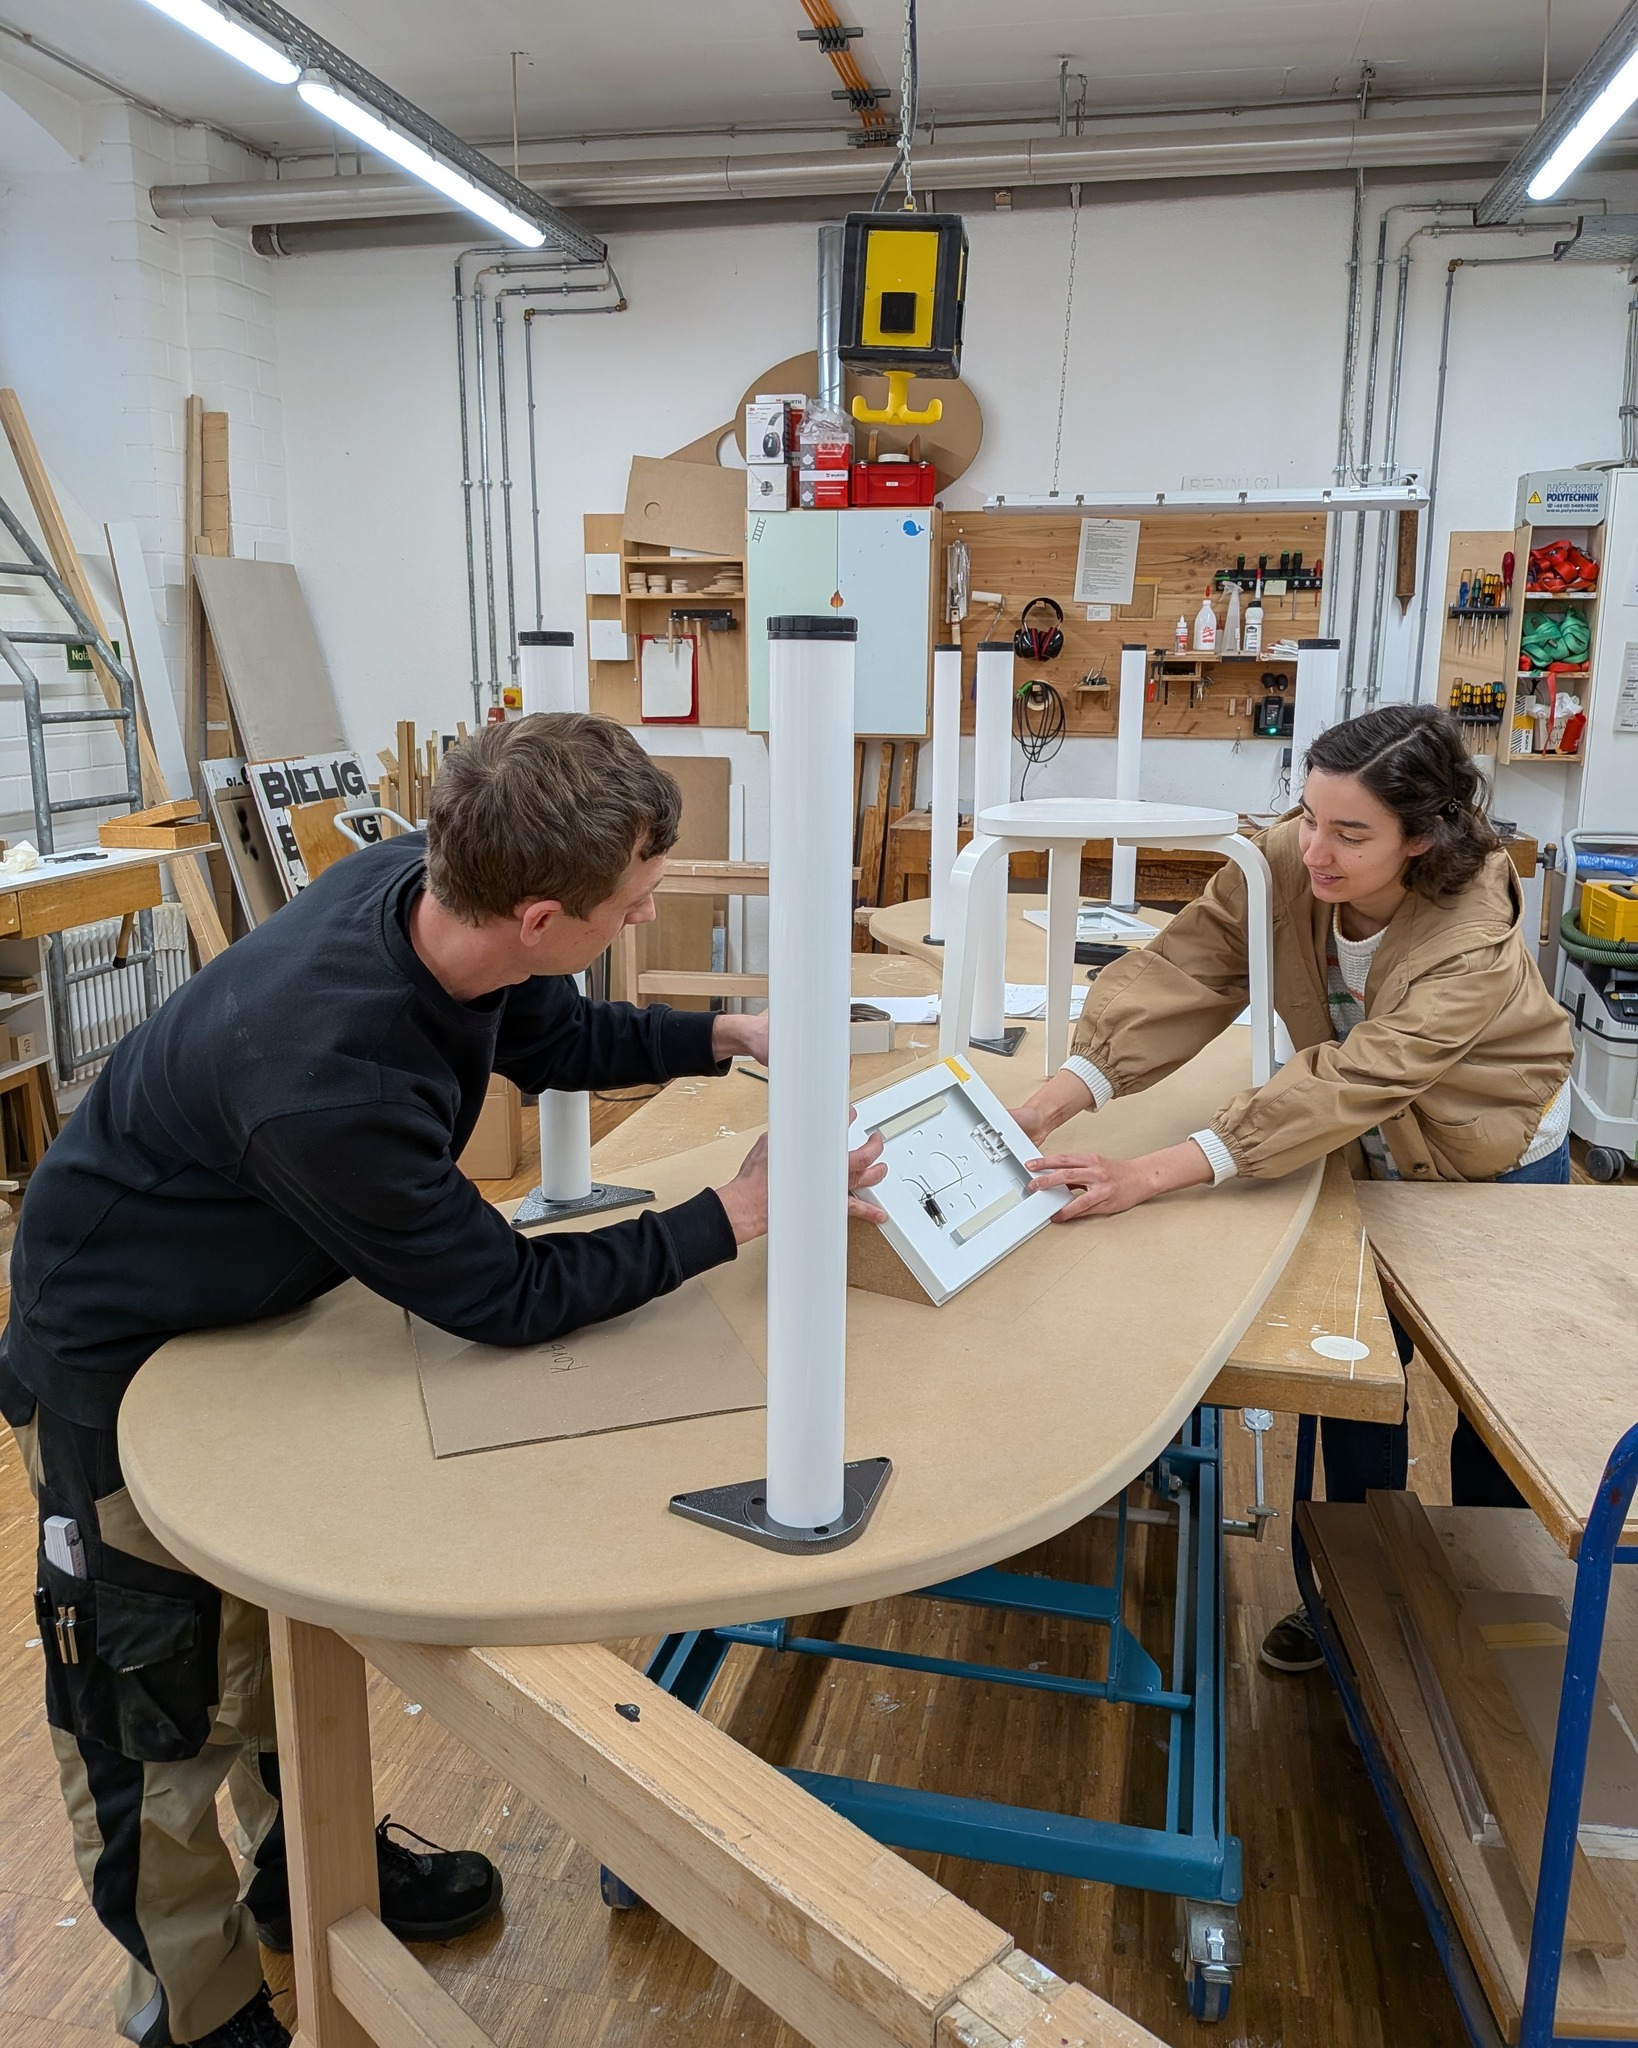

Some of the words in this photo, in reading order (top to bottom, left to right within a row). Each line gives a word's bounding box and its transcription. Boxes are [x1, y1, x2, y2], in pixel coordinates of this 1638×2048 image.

[1546, 482, 1600, 493] HÖCKER
[1546, 493, 1599, 502] POLYTECHNIK
[259, 760, 367, 809] BILLIG
[538, 1344, 589, 1374] Korb
